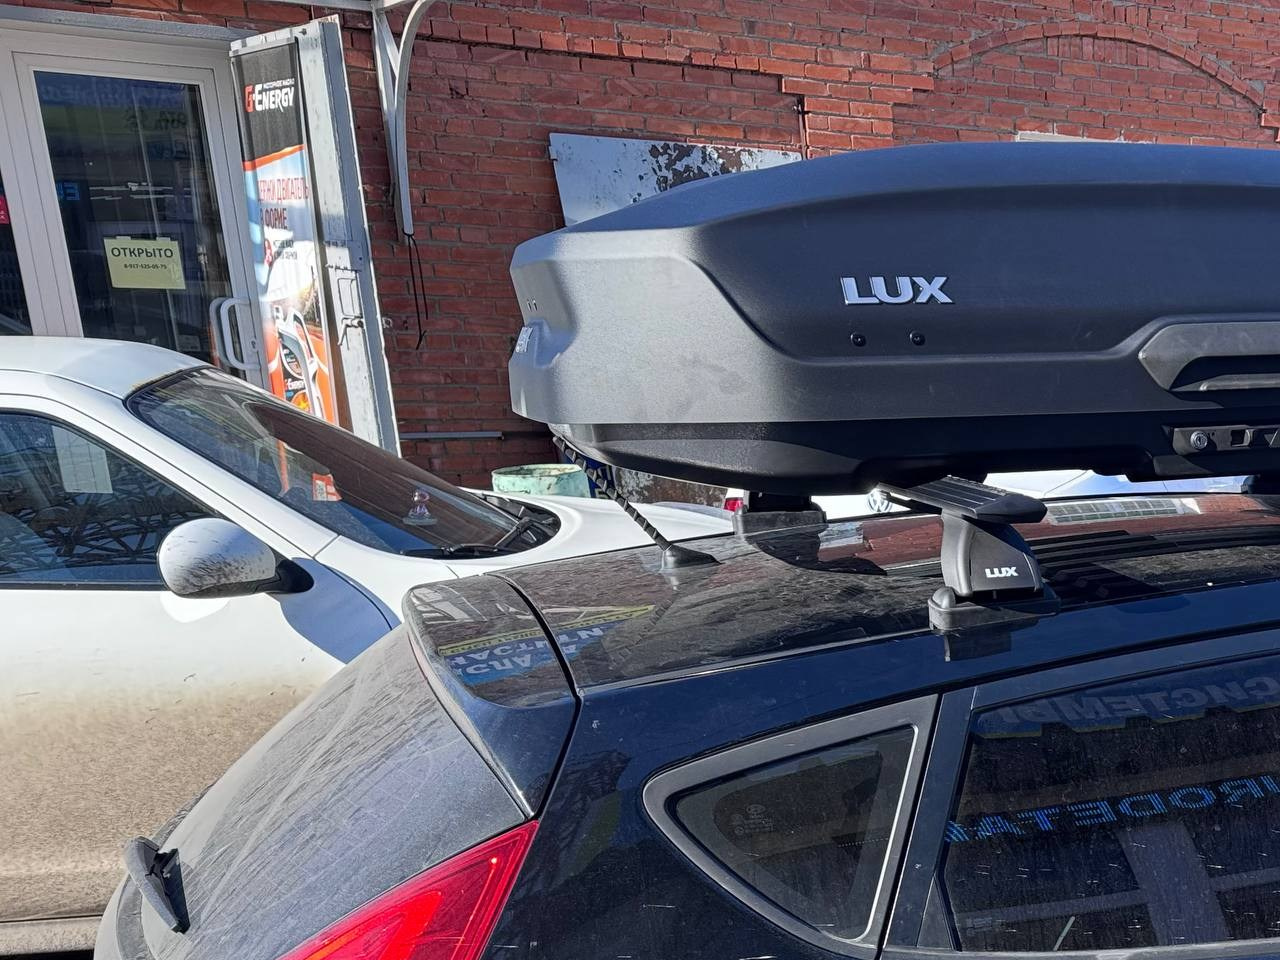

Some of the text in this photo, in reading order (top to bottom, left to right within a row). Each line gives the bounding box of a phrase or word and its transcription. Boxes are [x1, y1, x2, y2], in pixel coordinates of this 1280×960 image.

[111, 247, 174, 258] ОТКРЫТО
[840, 276, 953, 304] LUX
[984, 566, 1019, 578] LUX
